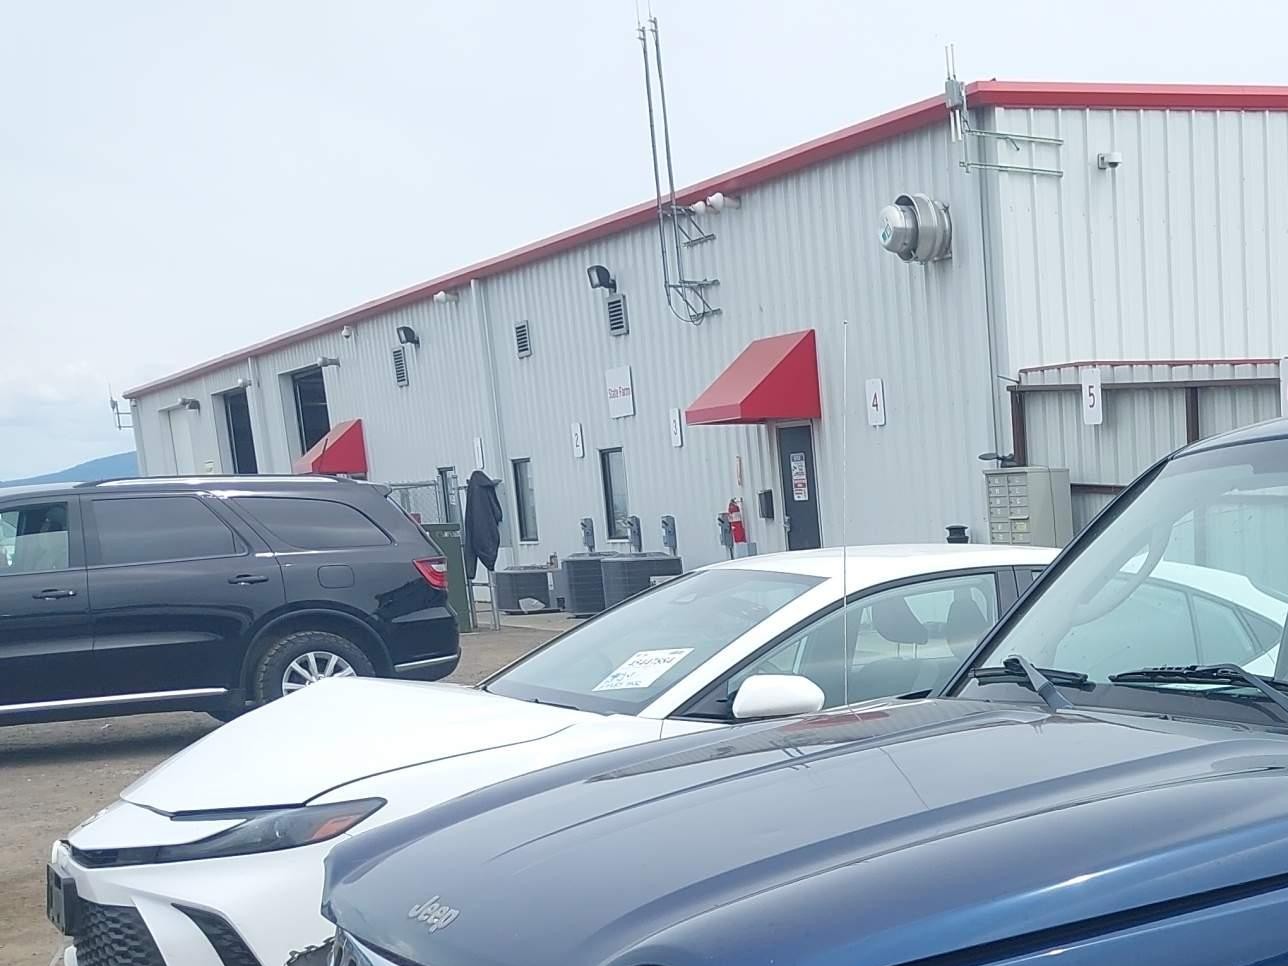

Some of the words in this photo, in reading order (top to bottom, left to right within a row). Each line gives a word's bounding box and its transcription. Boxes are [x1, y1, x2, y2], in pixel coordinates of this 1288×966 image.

[871, 391, 880, 412] 4
[1088, 385, 1096, 408] 5
[672, 419, 678, 436] 3
[574, 433, 580, 448] 2
[407, 895, 460, 935] Jeep
